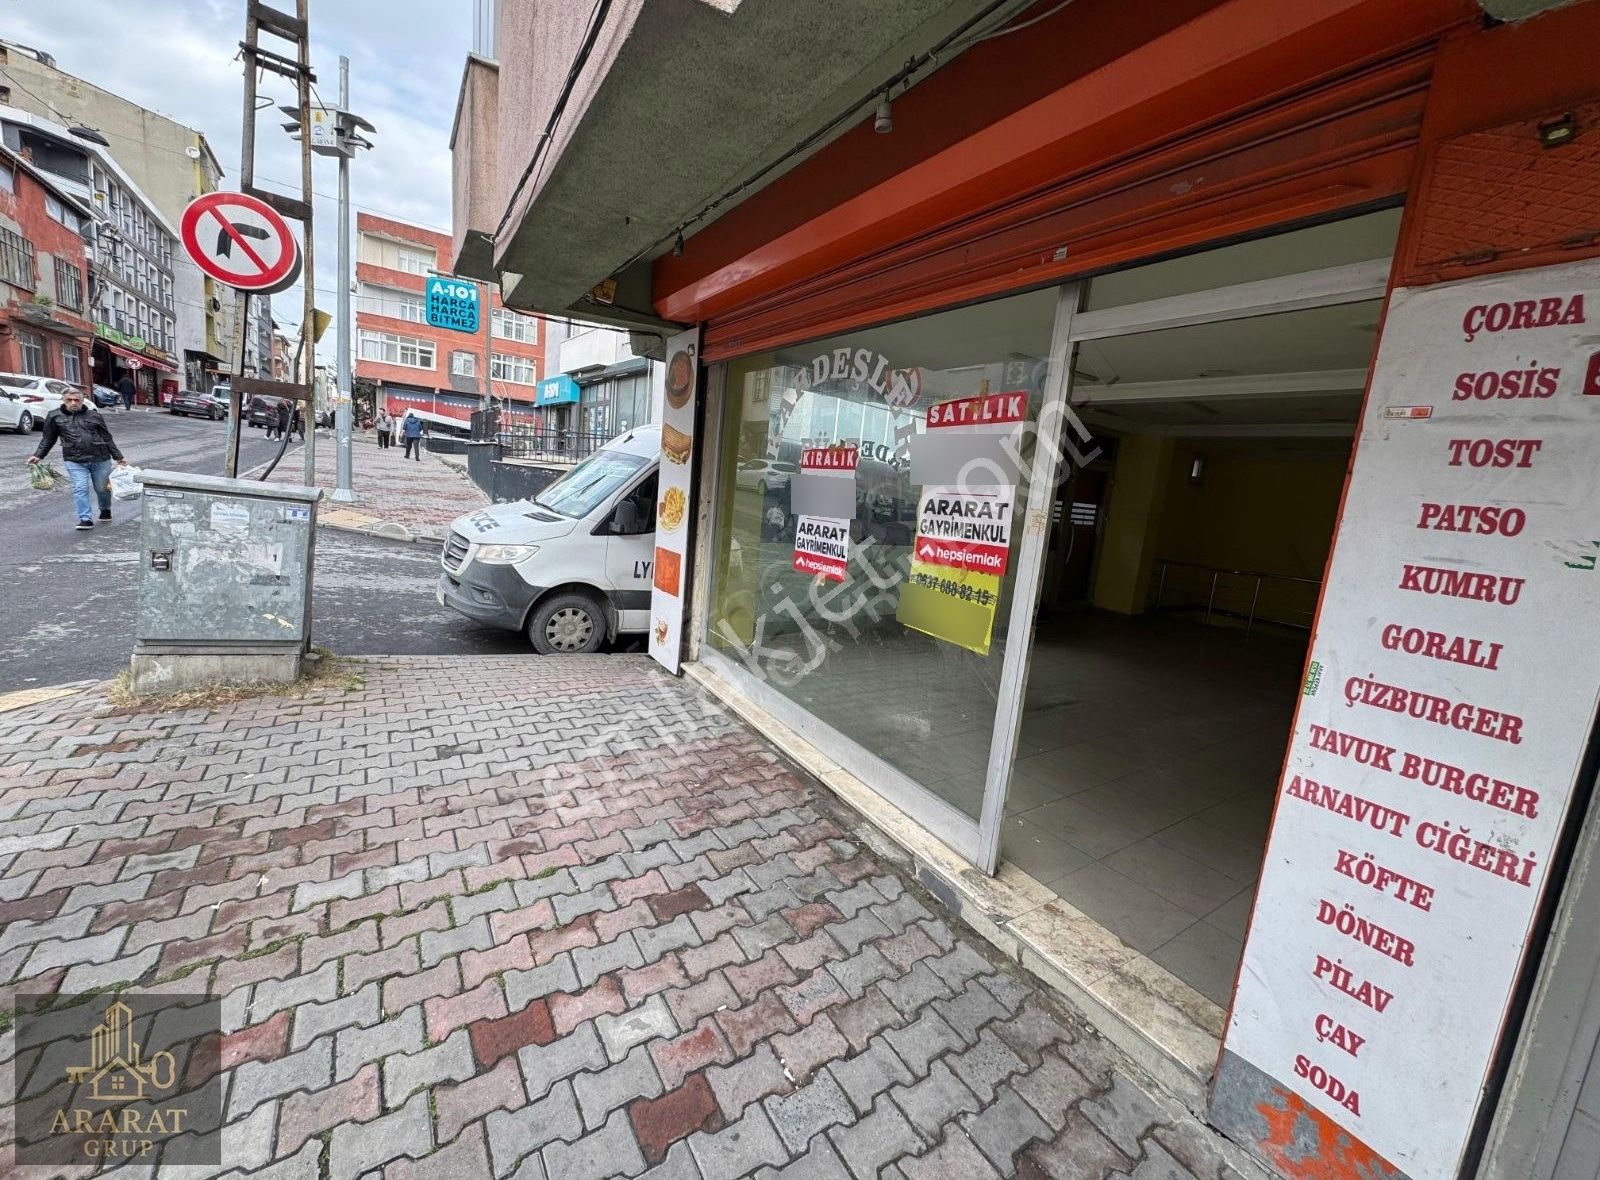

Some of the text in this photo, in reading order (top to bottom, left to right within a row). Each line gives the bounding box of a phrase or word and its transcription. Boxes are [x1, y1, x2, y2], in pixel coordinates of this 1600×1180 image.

[431, 294, 475, 312] HARCA
[431, 304, 475, 321] HARCA
[1463, 294, 1586, 343] ÇORBA
[1453, 360, 1561, 401] SOSİS
[1448, 438, 1542, 468] TOST
[919, 517, 1007, 544] GAYRİMENKUL
[924, 499, 1009, 521] ARARAT
[1417, 502, 1526, 538] PATSO
[796, 536, 846, 558] GAYRİMENKUL
[798, 522, 847, 542] ARARAT
[936, 546, 1002, 568] hepsiemlak
[1399, 564, 1525, 606] KUMRU
[1381, 623, 1503, 671] GORALI
[1344, 673, 1523, 745] ÇİZBURGER
[1309, 724, 1540, 819] TAVUK BURGER
[1285, 774, 1537, 888] ARNAVUT CİĞERİ
[1334, 850, 1435, 913] KÖFTE
[1316, 900, 1416, 968] DÖNER
[1313, 956, 1394, 1013] PİLAV
[1314, 1013, 1366, 1058] ÇAY
[1294, 1054, 1361, 1117] SODA
